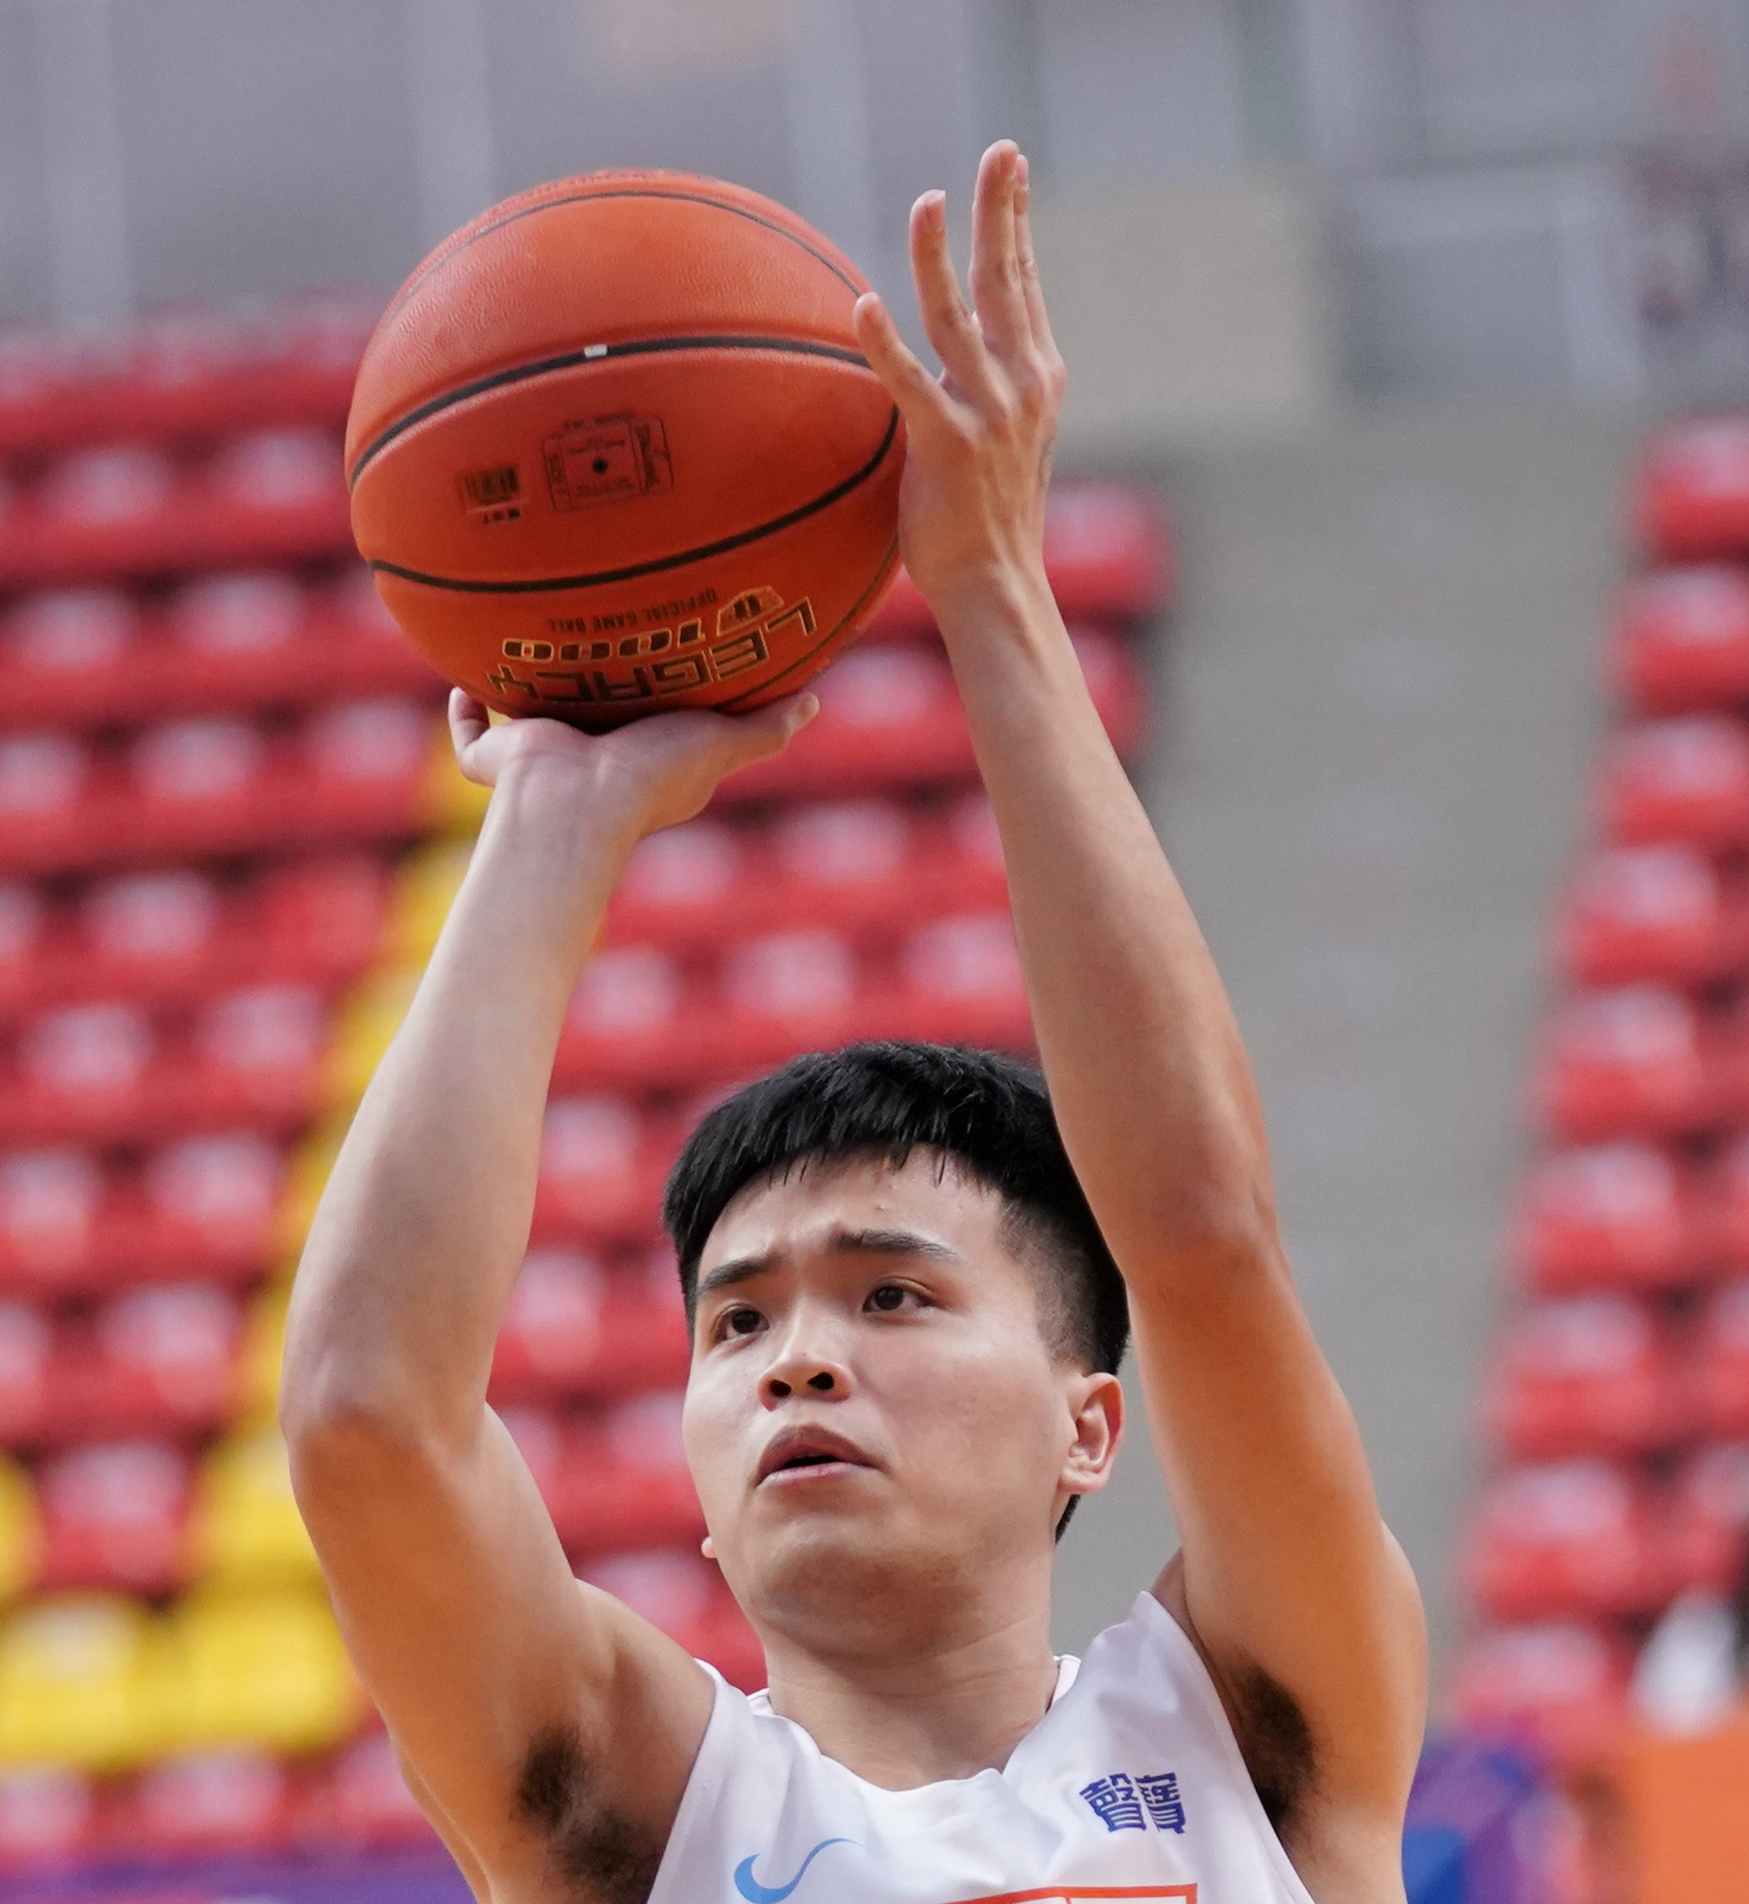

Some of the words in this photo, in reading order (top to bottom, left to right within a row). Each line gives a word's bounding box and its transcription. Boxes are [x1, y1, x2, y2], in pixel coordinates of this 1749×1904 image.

[642, 587, 718, 622] OFFICIAL
[548, 615, 587, 634] BALL
[592, 610, 638, 634] GAME
[485, 597, 818, 703] LEGACY
